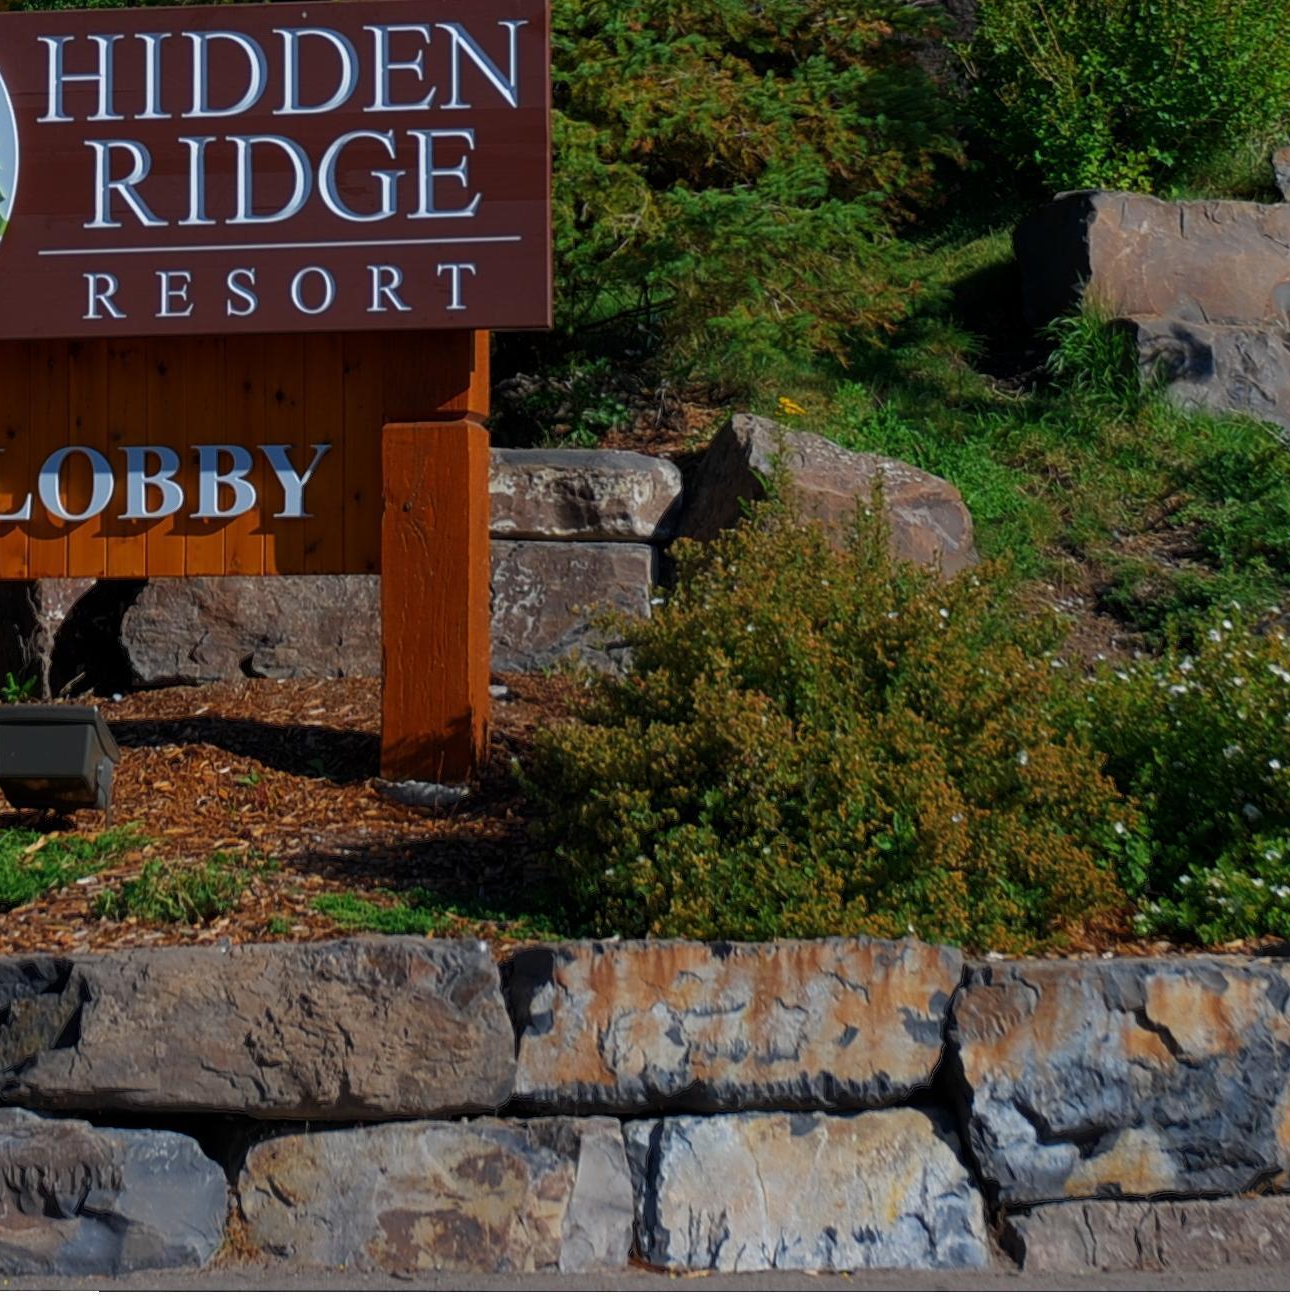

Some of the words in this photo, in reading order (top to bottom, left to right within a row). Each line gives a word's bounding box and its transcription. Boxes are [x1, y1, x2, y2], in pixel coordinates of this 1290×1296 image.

[36, 20, 529, 124] HIDDEN
[82, 128, 483, 230] RIDGE
[82, 262, 478, 320] RESORT
